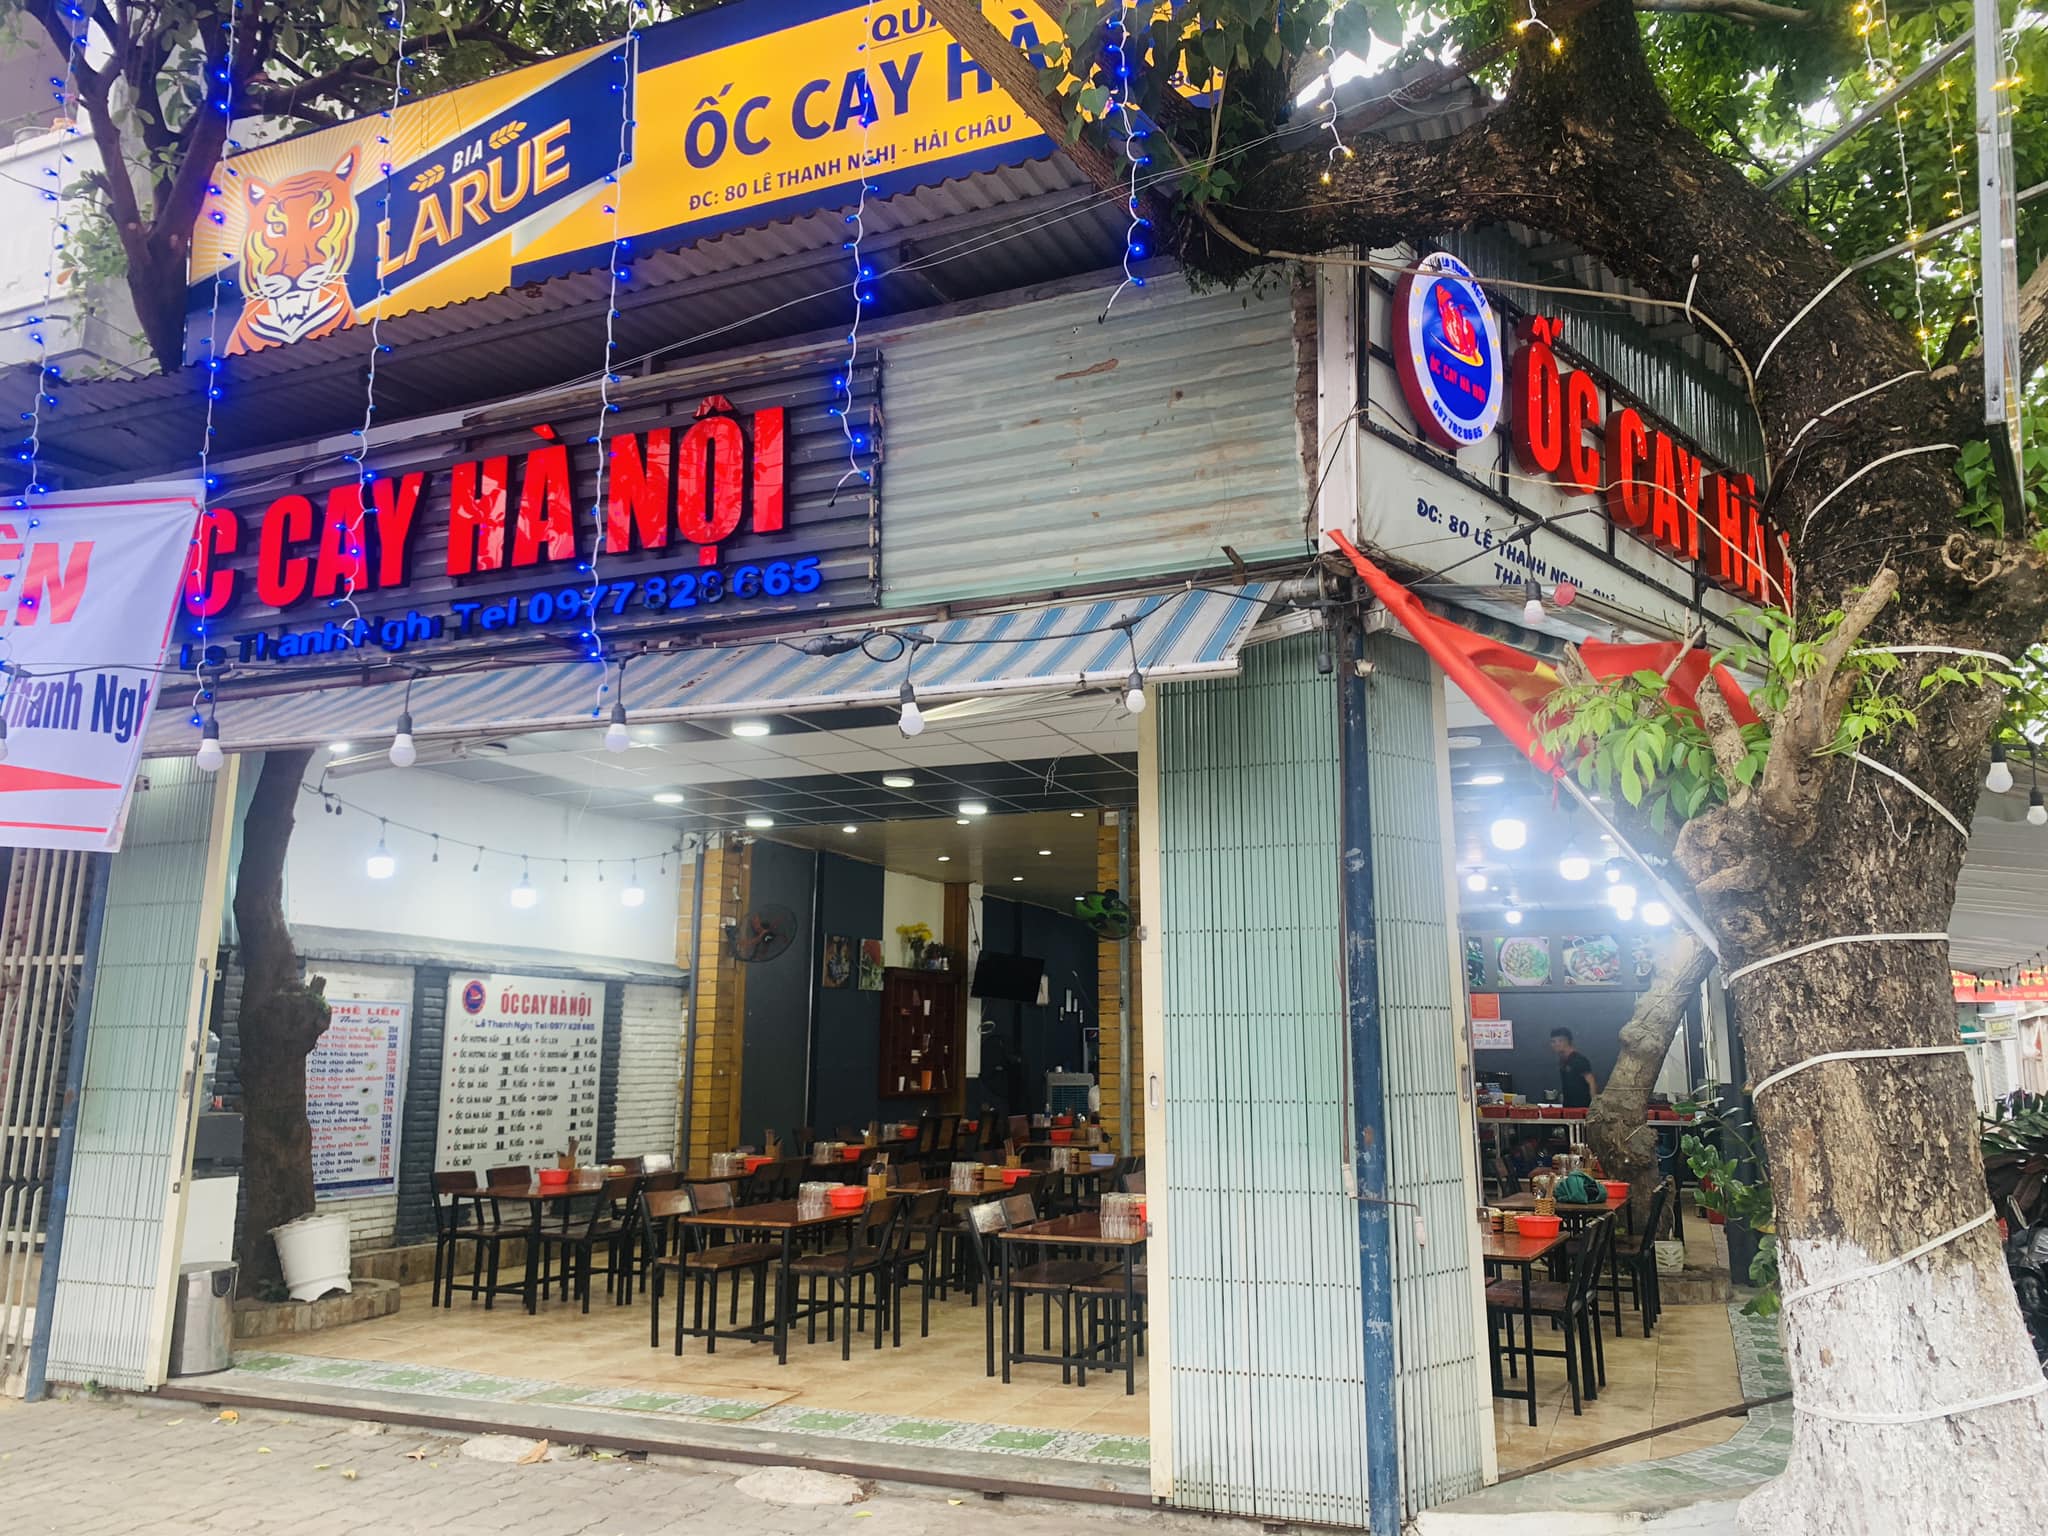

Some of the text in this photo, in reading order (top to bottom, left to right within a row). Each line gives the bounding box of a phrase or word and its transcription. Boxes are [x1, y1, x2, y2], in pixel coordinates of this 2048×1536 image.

[684, 82, 772, 169] ỐC
[791, 51, 924, 141] CAY
[376, 118, 572, 281] LARUE
[452, 143, 484, 174] BIA
[690, 191, 719, 211] ĐC:
[724, 182, 748, 203] 80
[753, 172, 772, 195] LÊ
[777, 157, 841, 189] THANH
[847, 143, 896, 171] NGHỊ
[913, 129, 948, 154] HẢI
[954, 114, 1012, 144] CHÂU
[1522, 313, 1600, 495] ỐC
[1615, 407, 1702, 561] CAY
[184, 395, 785, 618] C CAY HÀ NỘI
[1416, 497, 1443, 524] ĐC:
[1449, 514, 1470, 538] 80
[1474, 527, 1493, 549] LÊ
[1498, 538, 1547, 577] THANH
[233, 621, 350, 664] Thanh
[453, 596, 519, 631] Tel
[367, 1007, 400, 1016] LIÊN
[501, 984, 592, 1022] ỐC CAY HÀ NỘI
